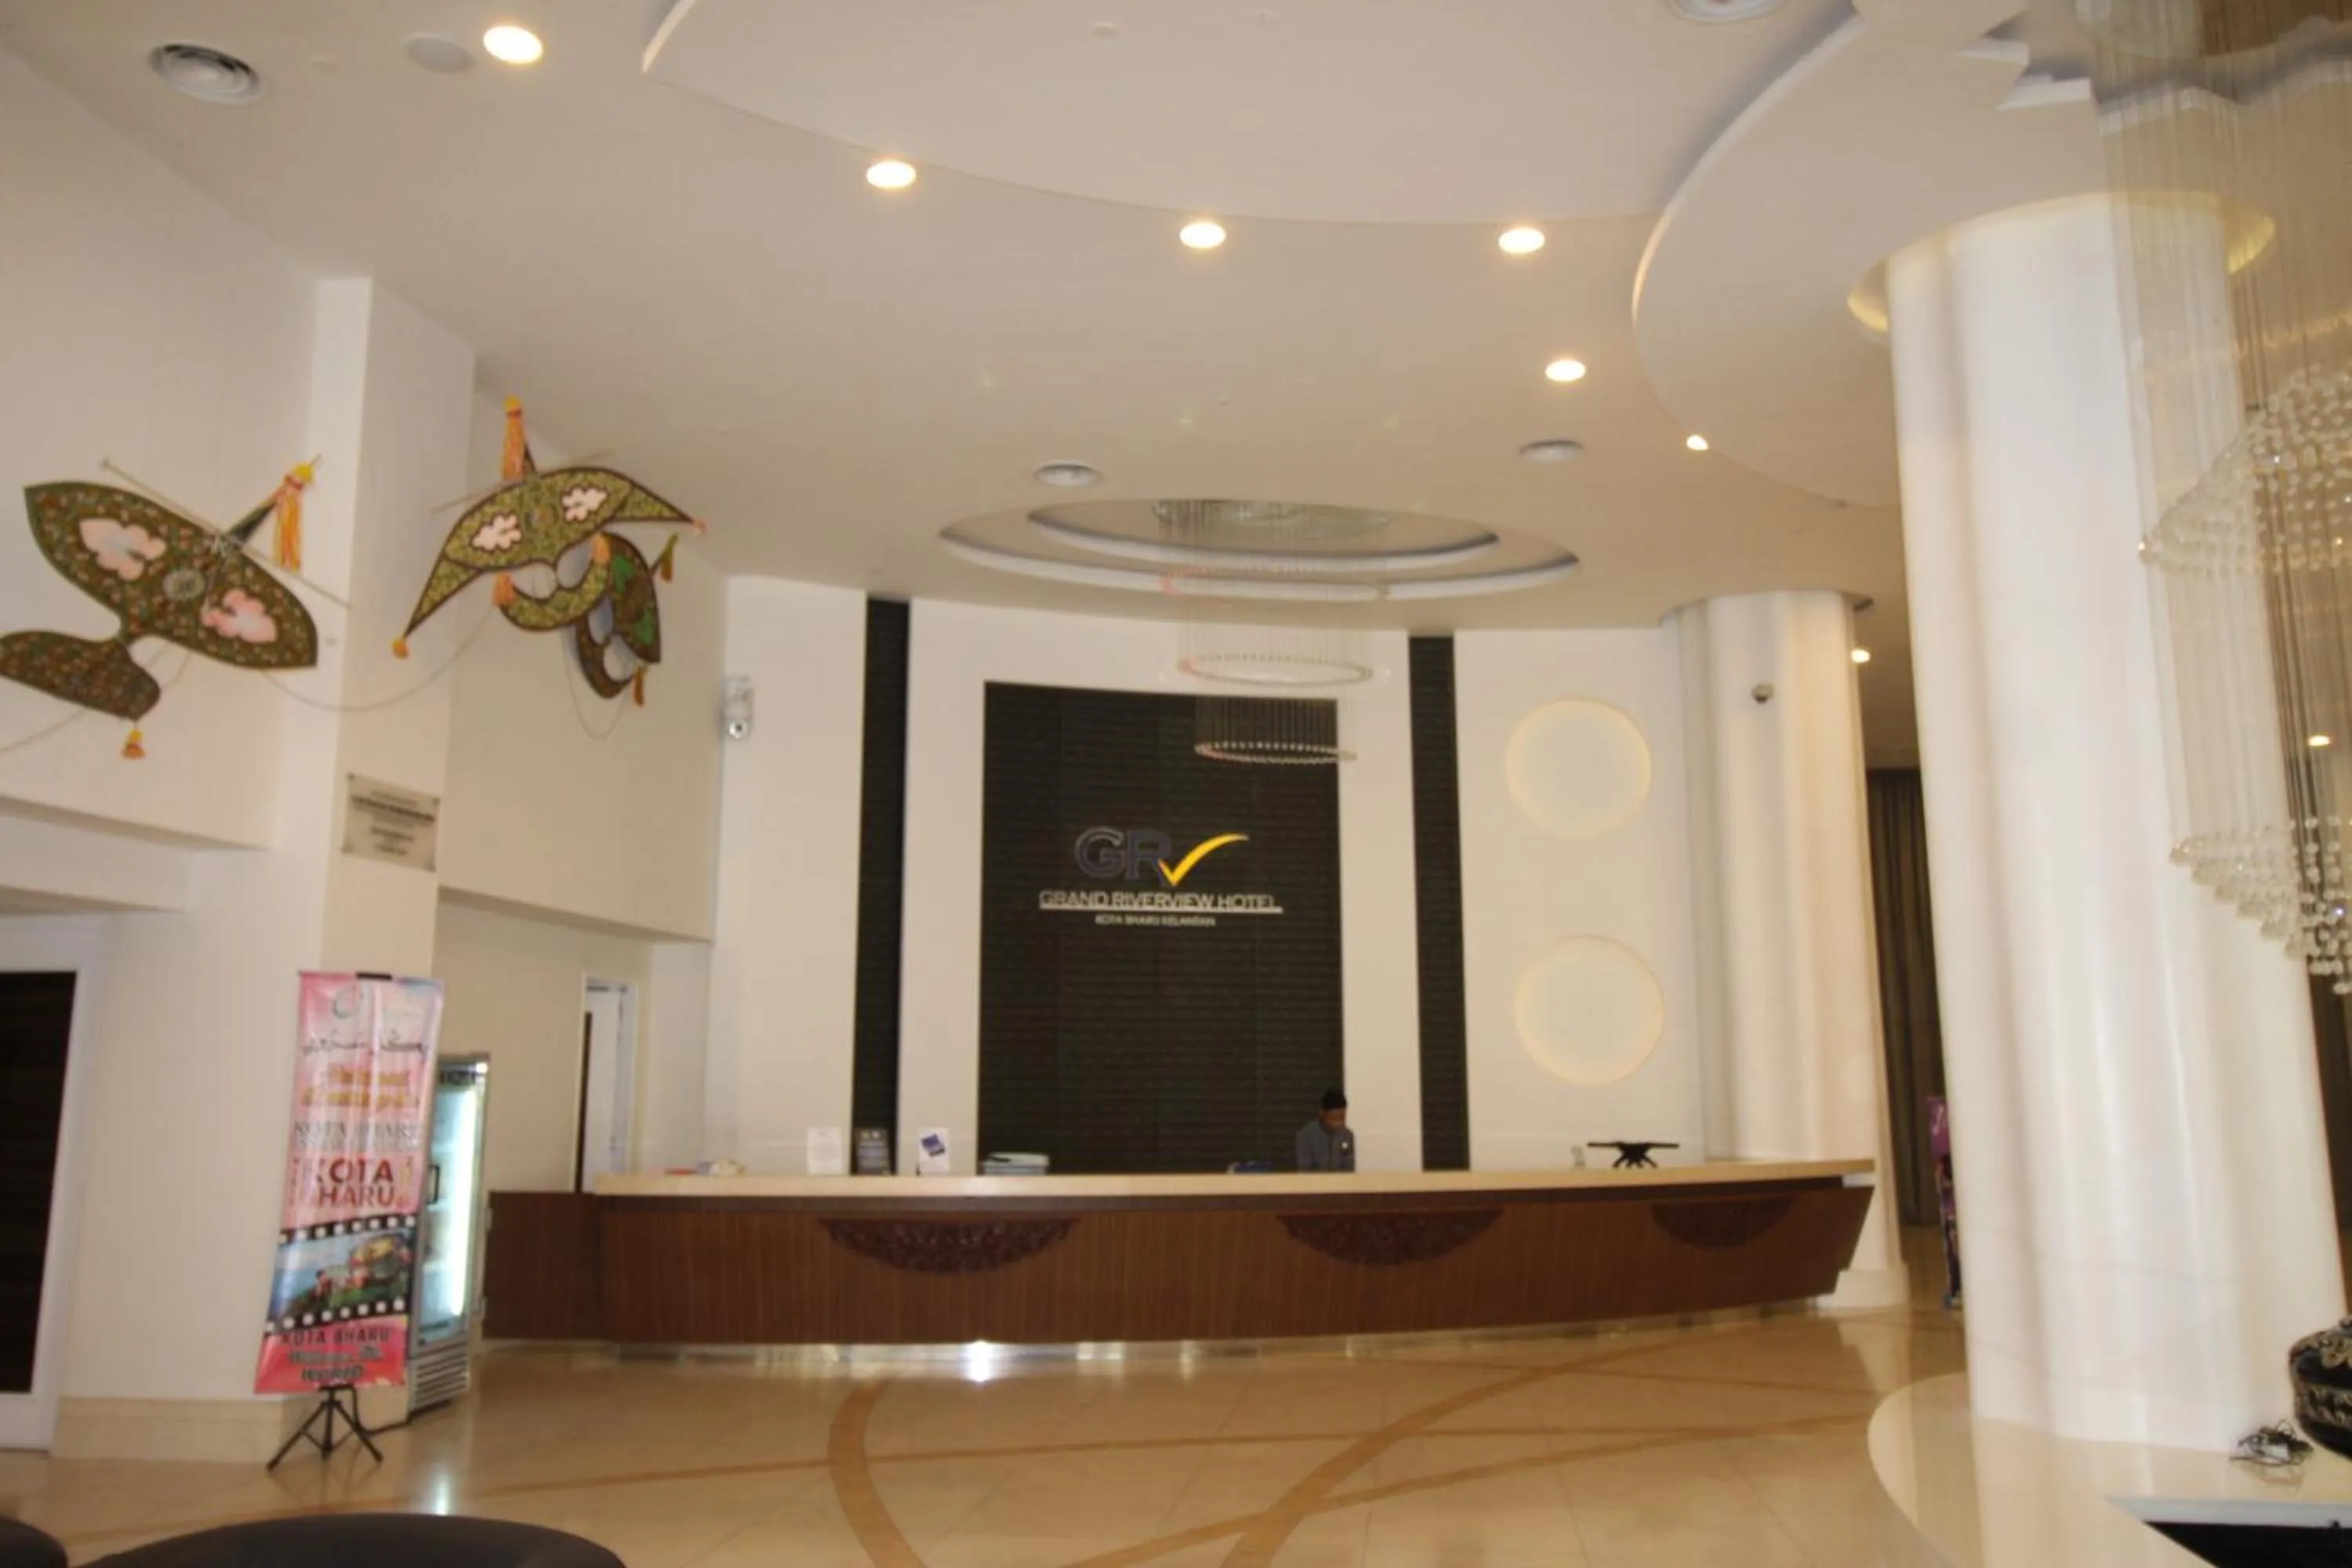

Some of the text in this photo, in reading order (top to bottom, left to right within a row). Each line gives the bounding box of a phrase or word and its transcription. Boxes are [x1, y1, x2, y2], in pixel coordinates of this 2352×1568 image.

[1039, 890, 1275, 911] GRAND RIVERVIEW HOTEL
